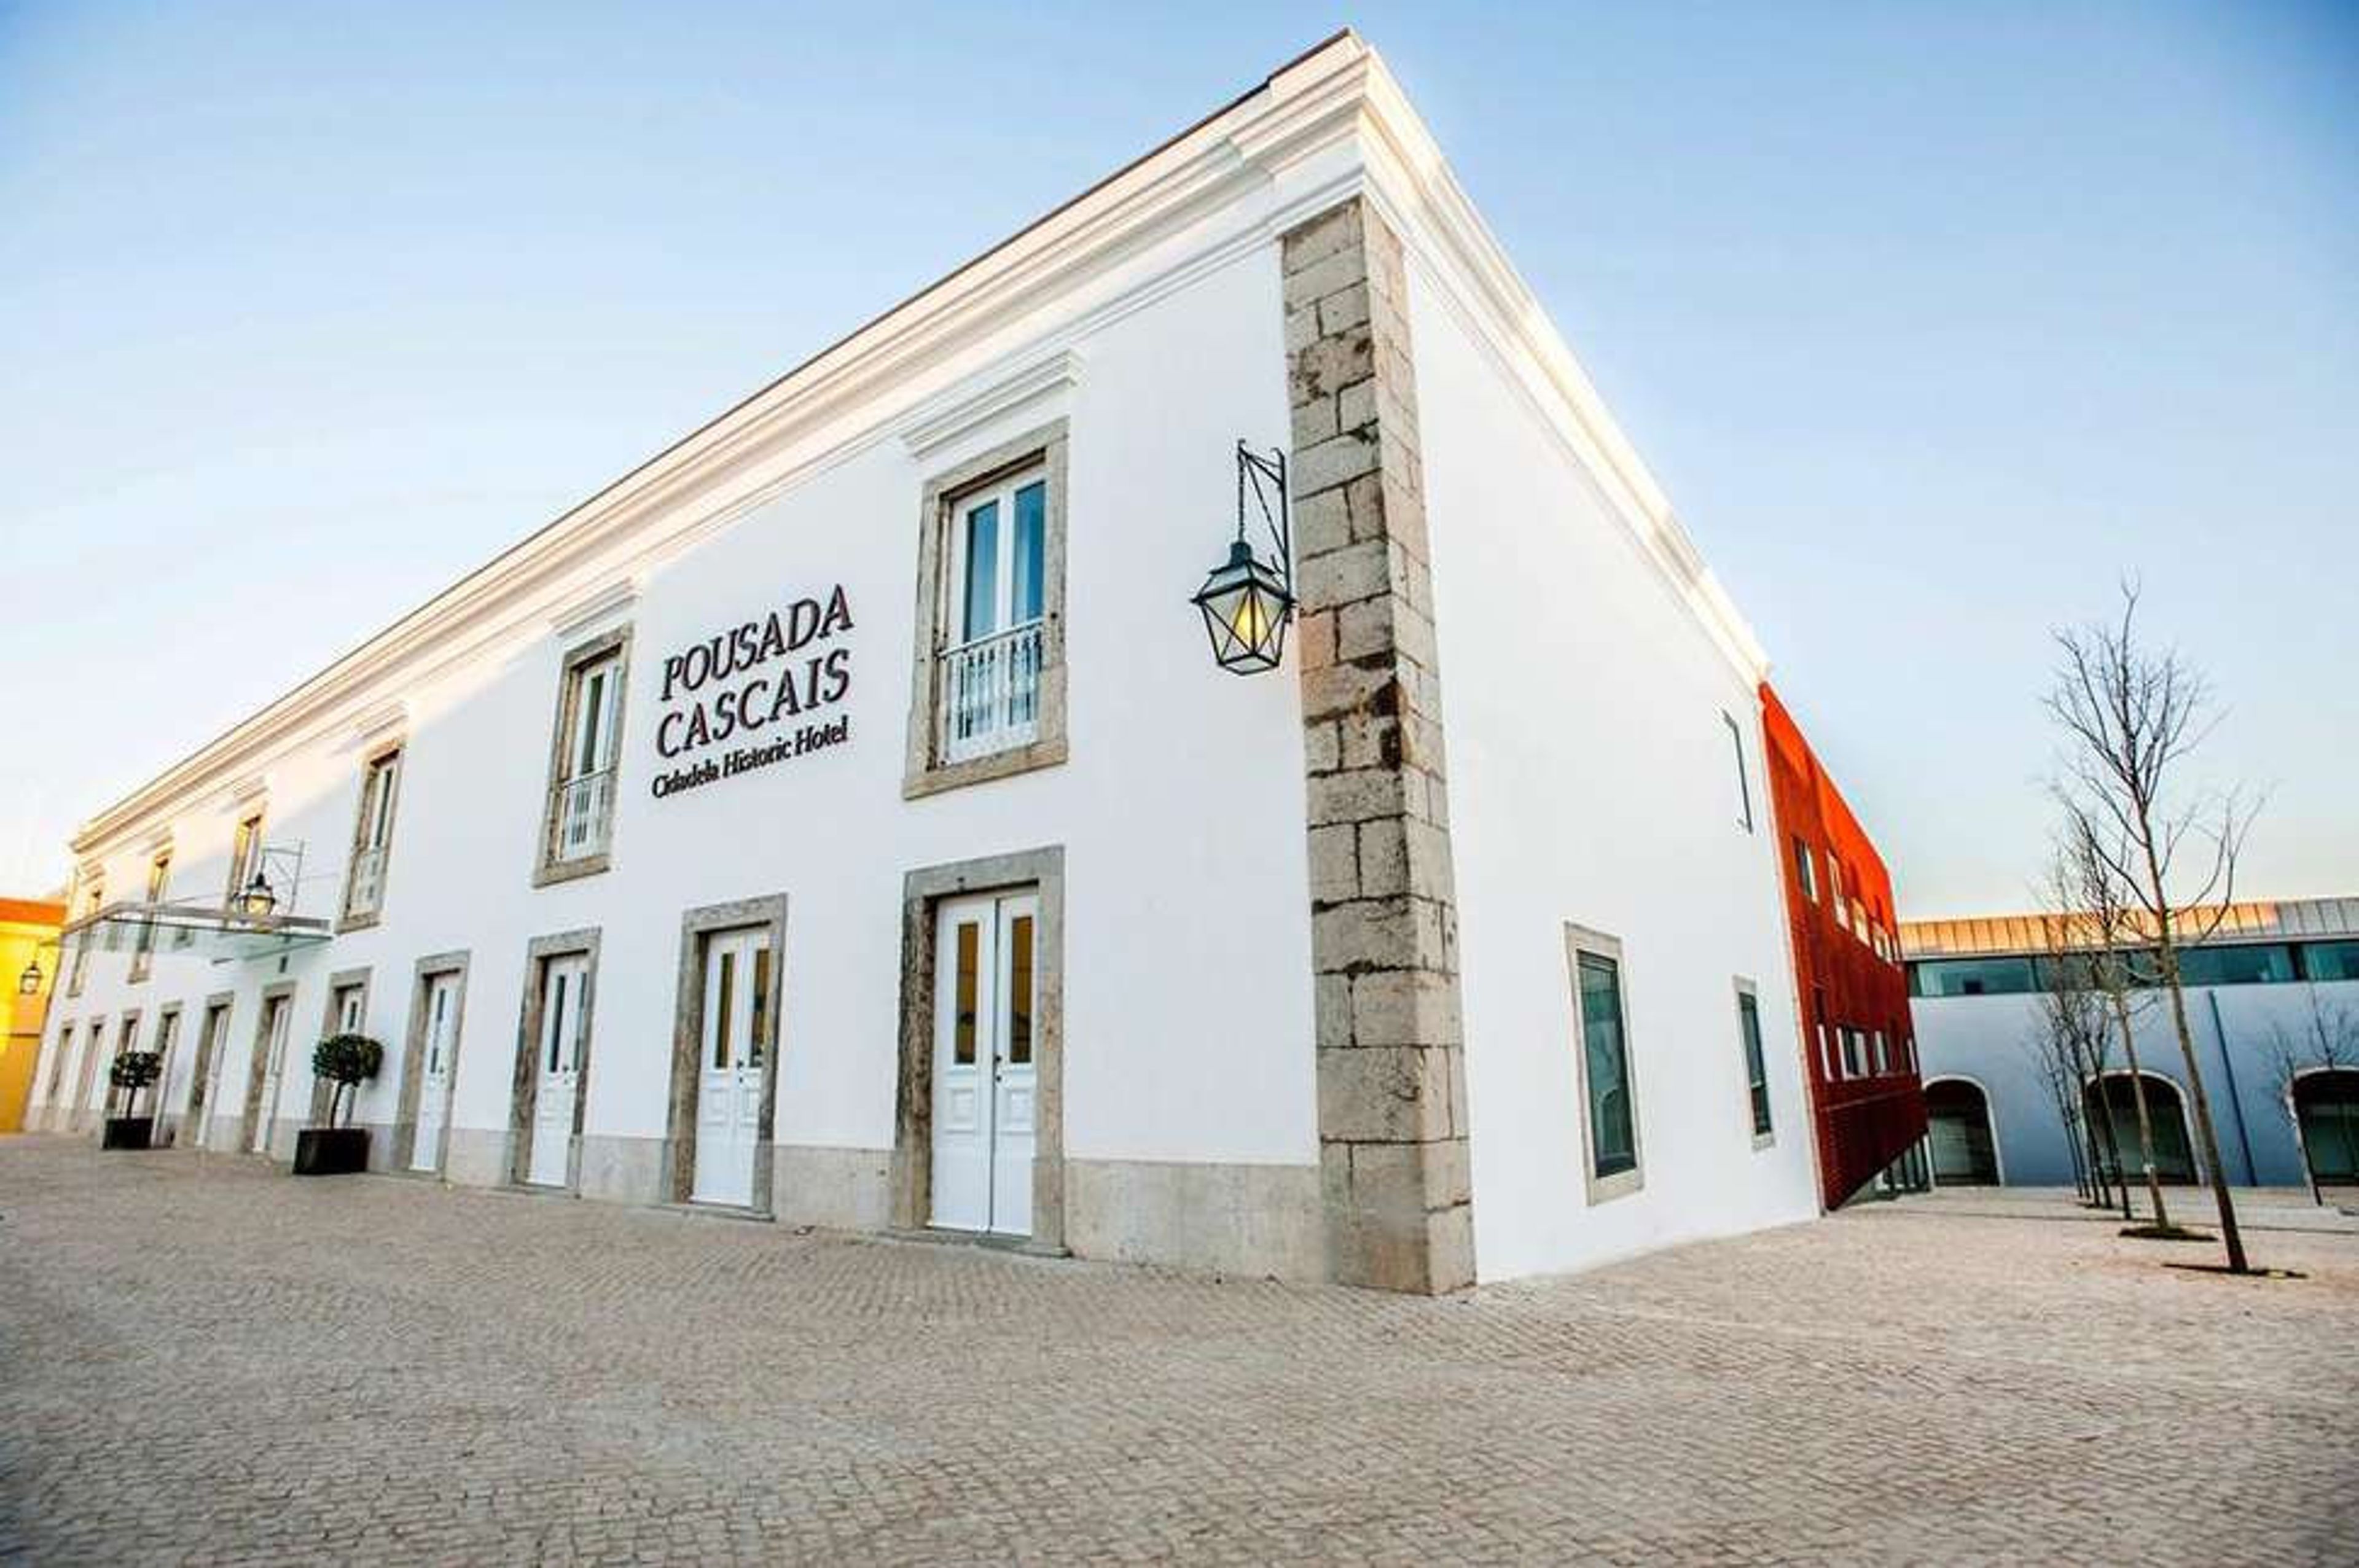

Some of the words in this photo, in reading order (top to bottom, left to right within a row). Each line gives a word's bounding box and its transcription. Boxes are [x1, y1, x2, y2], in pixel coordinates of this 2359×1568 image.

[660, 583, 854, 701] POUSADA
[652, 759, 720, 798] Cidadela
[723, 737, 792, 778] Historic
[795, 715, 848, 756] Hotel
[657, 649, 850, 757] CASCAIS
